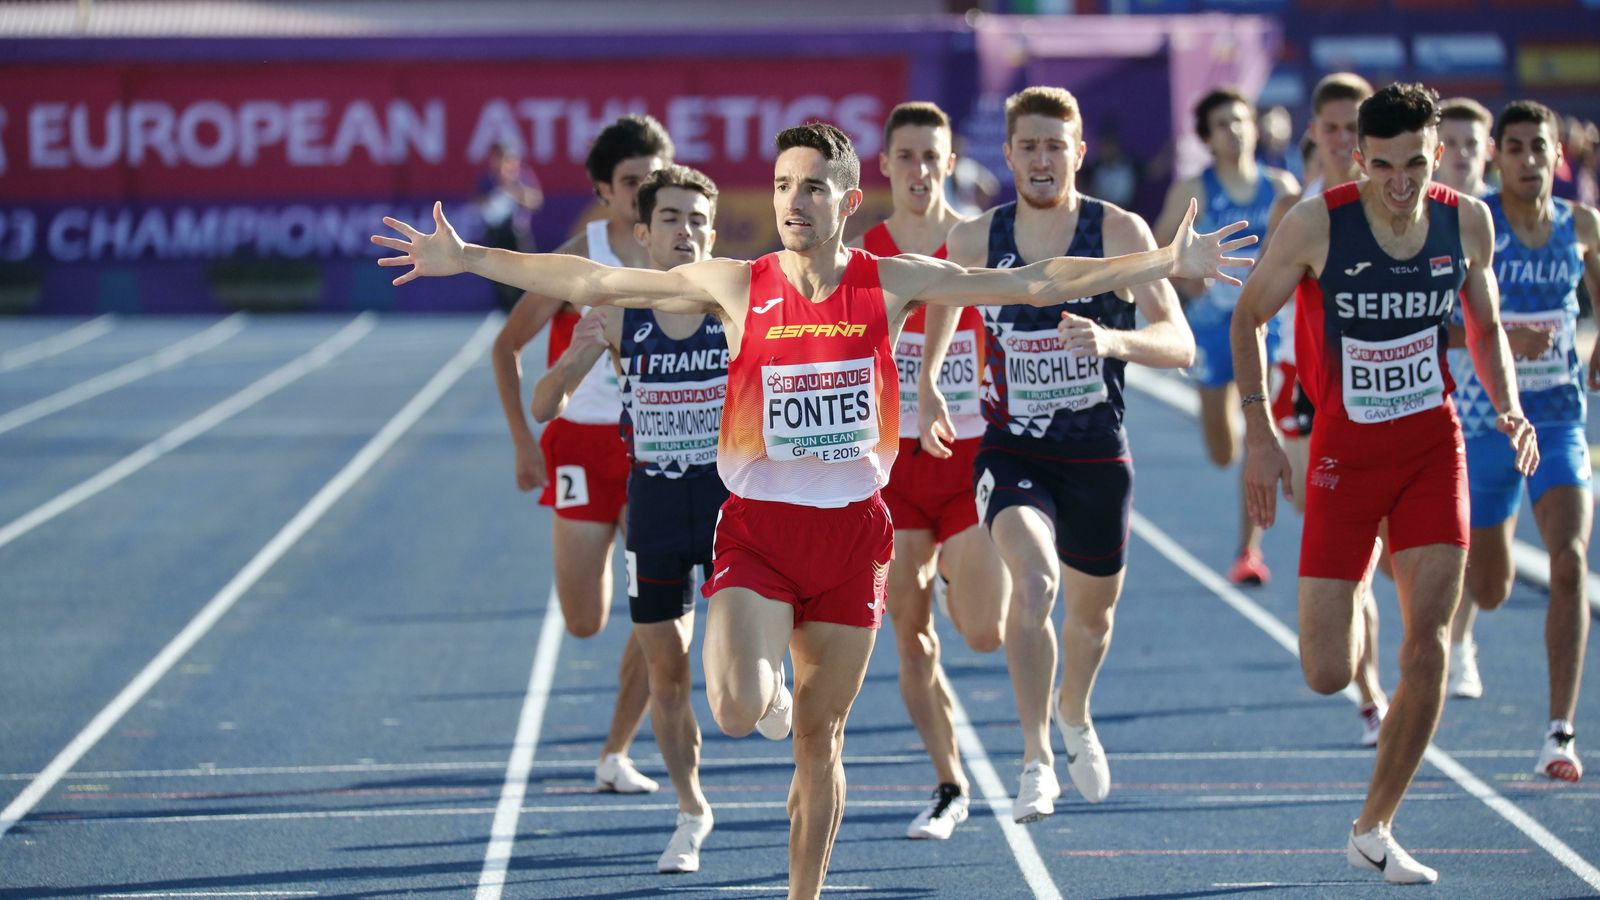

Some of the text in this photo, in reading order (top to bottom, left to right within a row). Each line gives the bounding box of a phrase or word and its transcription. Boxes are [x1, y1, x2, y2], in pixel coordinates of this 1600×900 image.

[27, 100, 447, 168] EUROPEAN
[1498, 260, 1570, 284] ITALIA
[1335, 288, 1455, 320] SERBIA
[765, 321, 867, 340] ESPAÑA
[1361, 336, 1434, 362] BAUHAUS
[783, 368, 871, 393] BAUHAUS
[1009, 355, 1099, 385] MISCHLER
[1351, 356, 1432, 392] BIBIC
[650, 384, 726, 403] BAUHAUS
[769, 390, 870, 430] FONTES
[819, 433, 854, 445] CLEAN
[833, 446, 860, 460] 2019
[561, 475, 577, 500] 2
